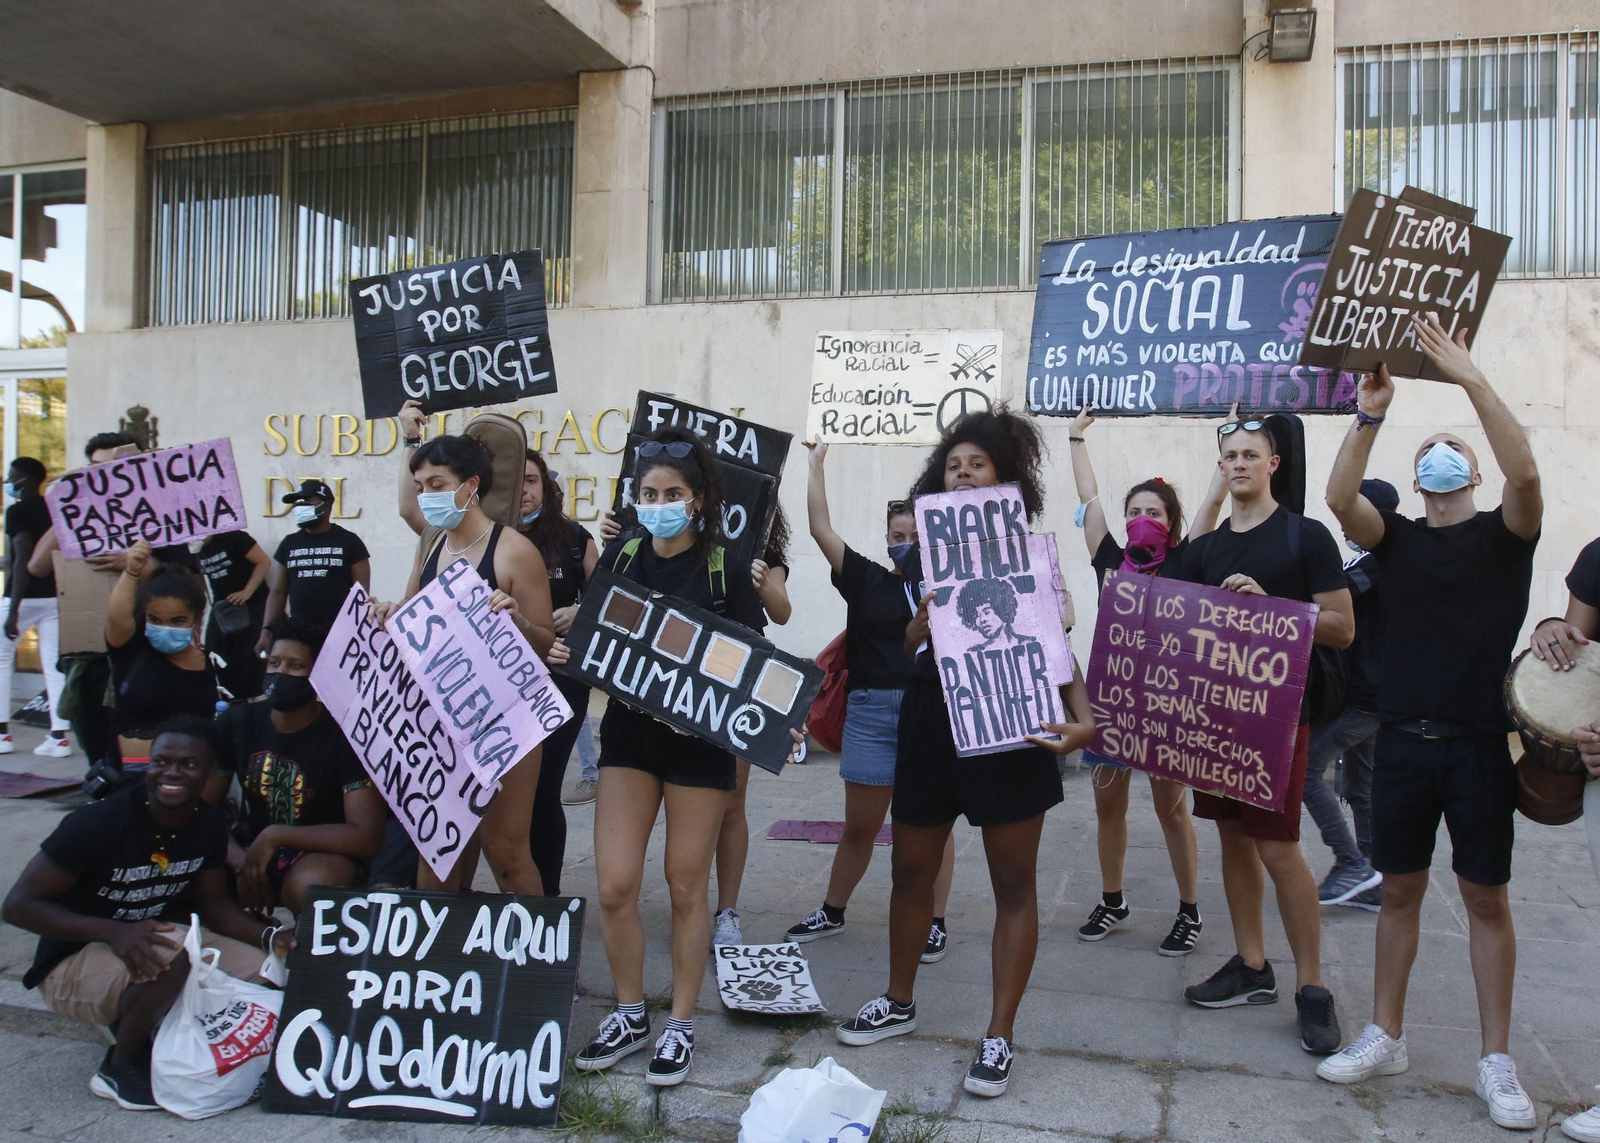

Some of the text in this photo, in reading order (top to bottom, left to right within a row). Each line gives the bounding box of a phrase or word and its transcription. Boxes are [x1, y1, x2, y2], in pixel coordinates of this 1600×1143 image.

[1052, 225, 1306, 291] La desigualdad
[1389, 205, 1470, 257] TIERRA
[359, 258, 522, 315] JUSTICIA
[1082, 273, 1252, 340] SOCIAL
[1336, 244, 1480, 312] JUSTICIA
[417, 303, 483, 343] POR
[816, 333, 923, 359] Ignorancia
[400, 336, 550, 399] GEORGE
[846, 355, 910, 371] Racial
[1044, 343, 1068, 368] ES
[1077, 340, 1126, 368] MÁS
[1139, 340, 1246, 365] VIOLENTA
[811, 382, 913, 405] Educación
[1029, 363, 1358, 412] CUALQUIER PROTESTA
[647, 400, 759, 465] FUERA
[821, 409, 917, 437] Racial
[59, 444, 225, 503] JUSTICIA
[262, 476, 362, 519] DL
[60, 497, 157, 530] PARA
[76, 495, 238, 556] BREONNA
[924, 498, 1031, 583] BLACK
[438, 557, 565, 732] EL SILENCIO BLANCO
[1155, 595, 1185, 620] LOS
[1199, 598, 1299, 641] DERECHOS
[347, 589, 457, 773] RECONOCES
[1109, 623, 1289, 686] QUE YO TENGO
[394, 595, 519, 783] ES VIOLENCIA
[581, 631, 766, 750] HUMAN@
[941, 642, 1057, 749] PANTHER
[1098, 681, 1135, 708] LOS
[1107, 654, 1268, 715] NO LOS TIENEN
[339, 637, 446, 803] PRIVILEGIO
[1117, 712, 1136, 731] NO
[1175, 726, 1264, 770] DERECHOS
[1102, 726, 1273, 800] SON PRIVILEGIOS
[311, 892, 449, 961] ESTOY
[719, 946, 803, 960] BLACK
[346, 970, 482, 1016] PARA
[730, 958, 804, 974] LIVES
